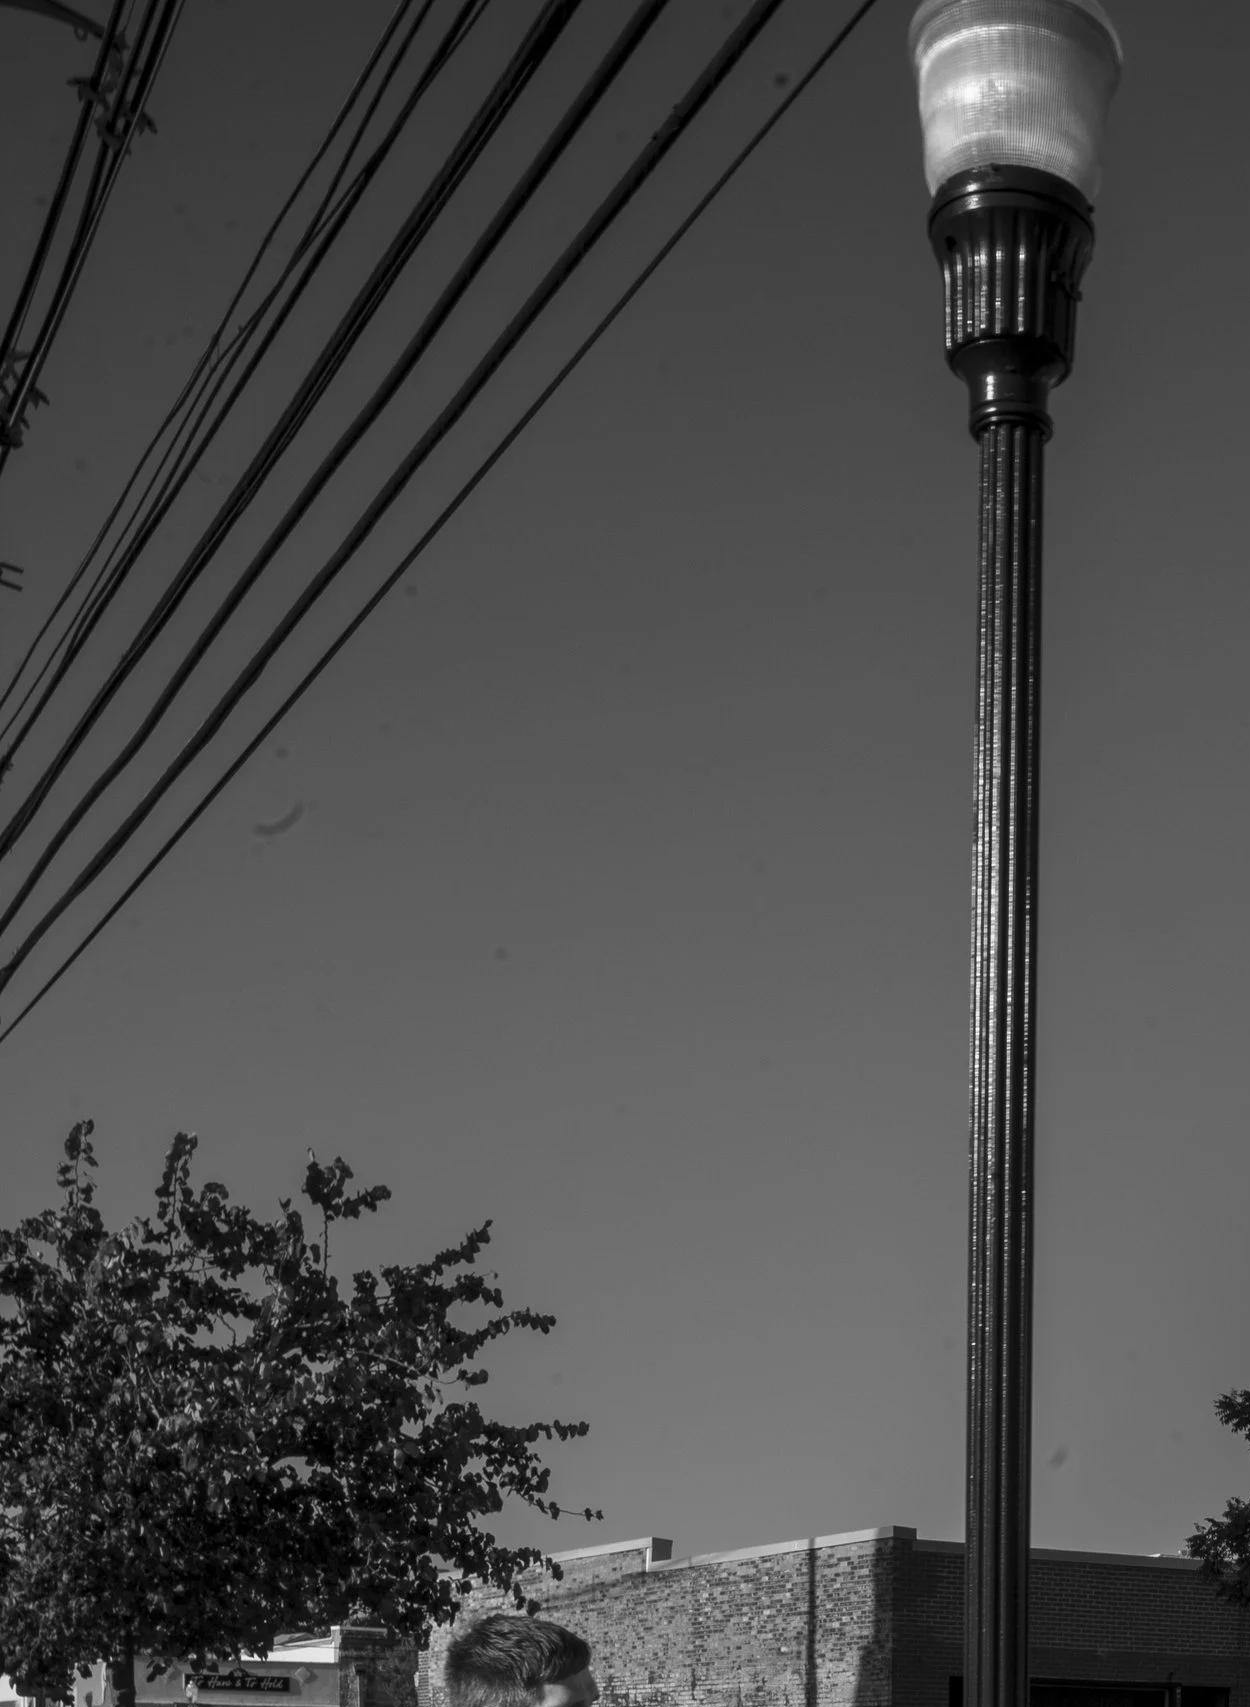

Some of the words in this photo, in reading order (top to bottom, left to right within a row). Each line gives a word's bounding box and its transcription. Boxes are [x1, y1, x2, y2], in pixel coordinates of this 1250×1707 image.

[207, 1675, 232, 1688] Have
[235, 1679, 242, 1688] &
[245, 1677, 256, 1688] To
[260, 1677, 284, 1690] Hold
